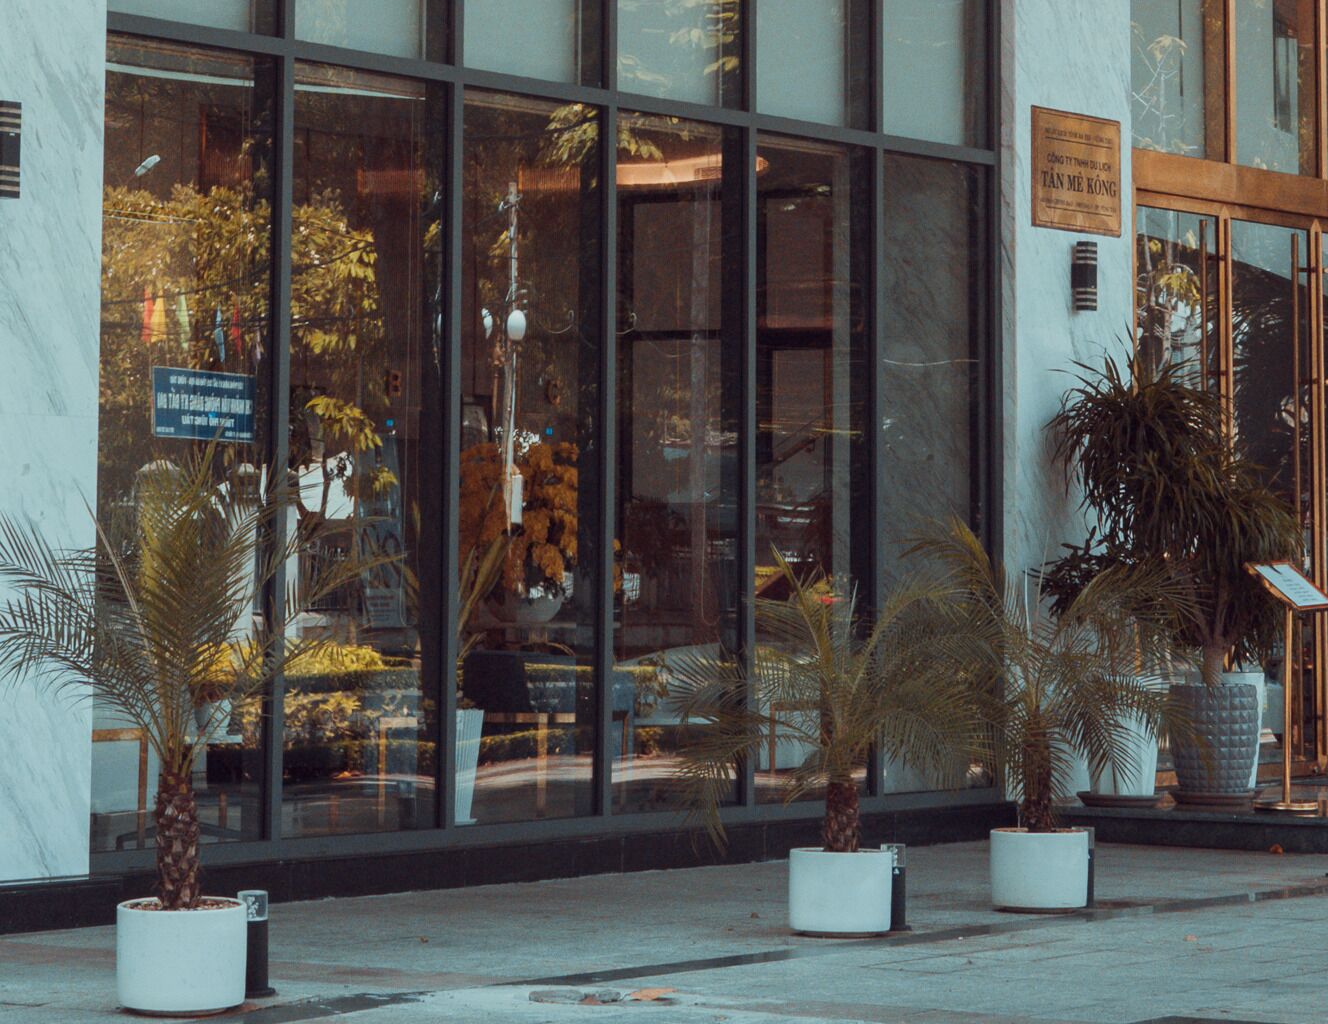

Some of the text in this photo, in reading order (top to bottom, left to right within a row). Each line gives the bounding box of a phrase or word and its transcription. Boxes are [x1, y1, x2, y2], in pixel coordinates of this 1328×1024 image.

[1065, 156, 1073, 166] TY
[1041, 167, 1065, 190] TÂN
[1086, 174, 1117, 198] KÔNG
